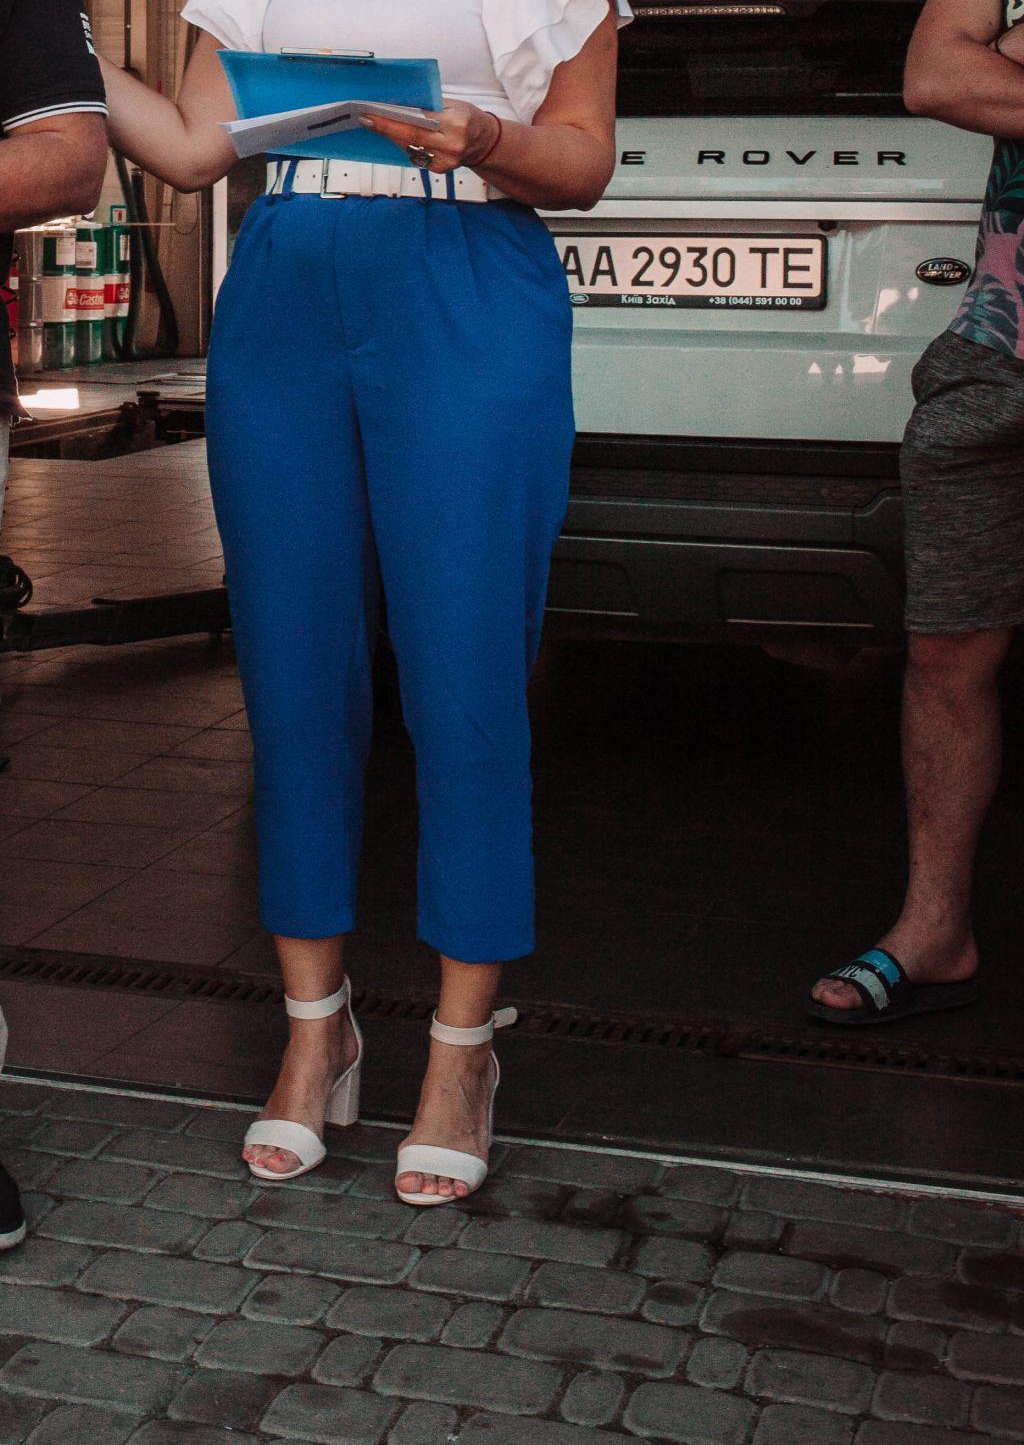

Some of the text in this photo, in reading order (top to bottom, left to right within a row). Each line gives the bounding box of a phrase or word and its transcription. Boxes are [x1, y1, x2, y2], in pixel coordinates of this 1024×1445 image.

[696, 150, 908, 167] ROVER
[563, 245, 814, 289] AA 2930 TE
[621, 294, 676, 305] Київ Захід
[708, 297, 727, 305] +38
[728, 297, 753, 306] (044)
